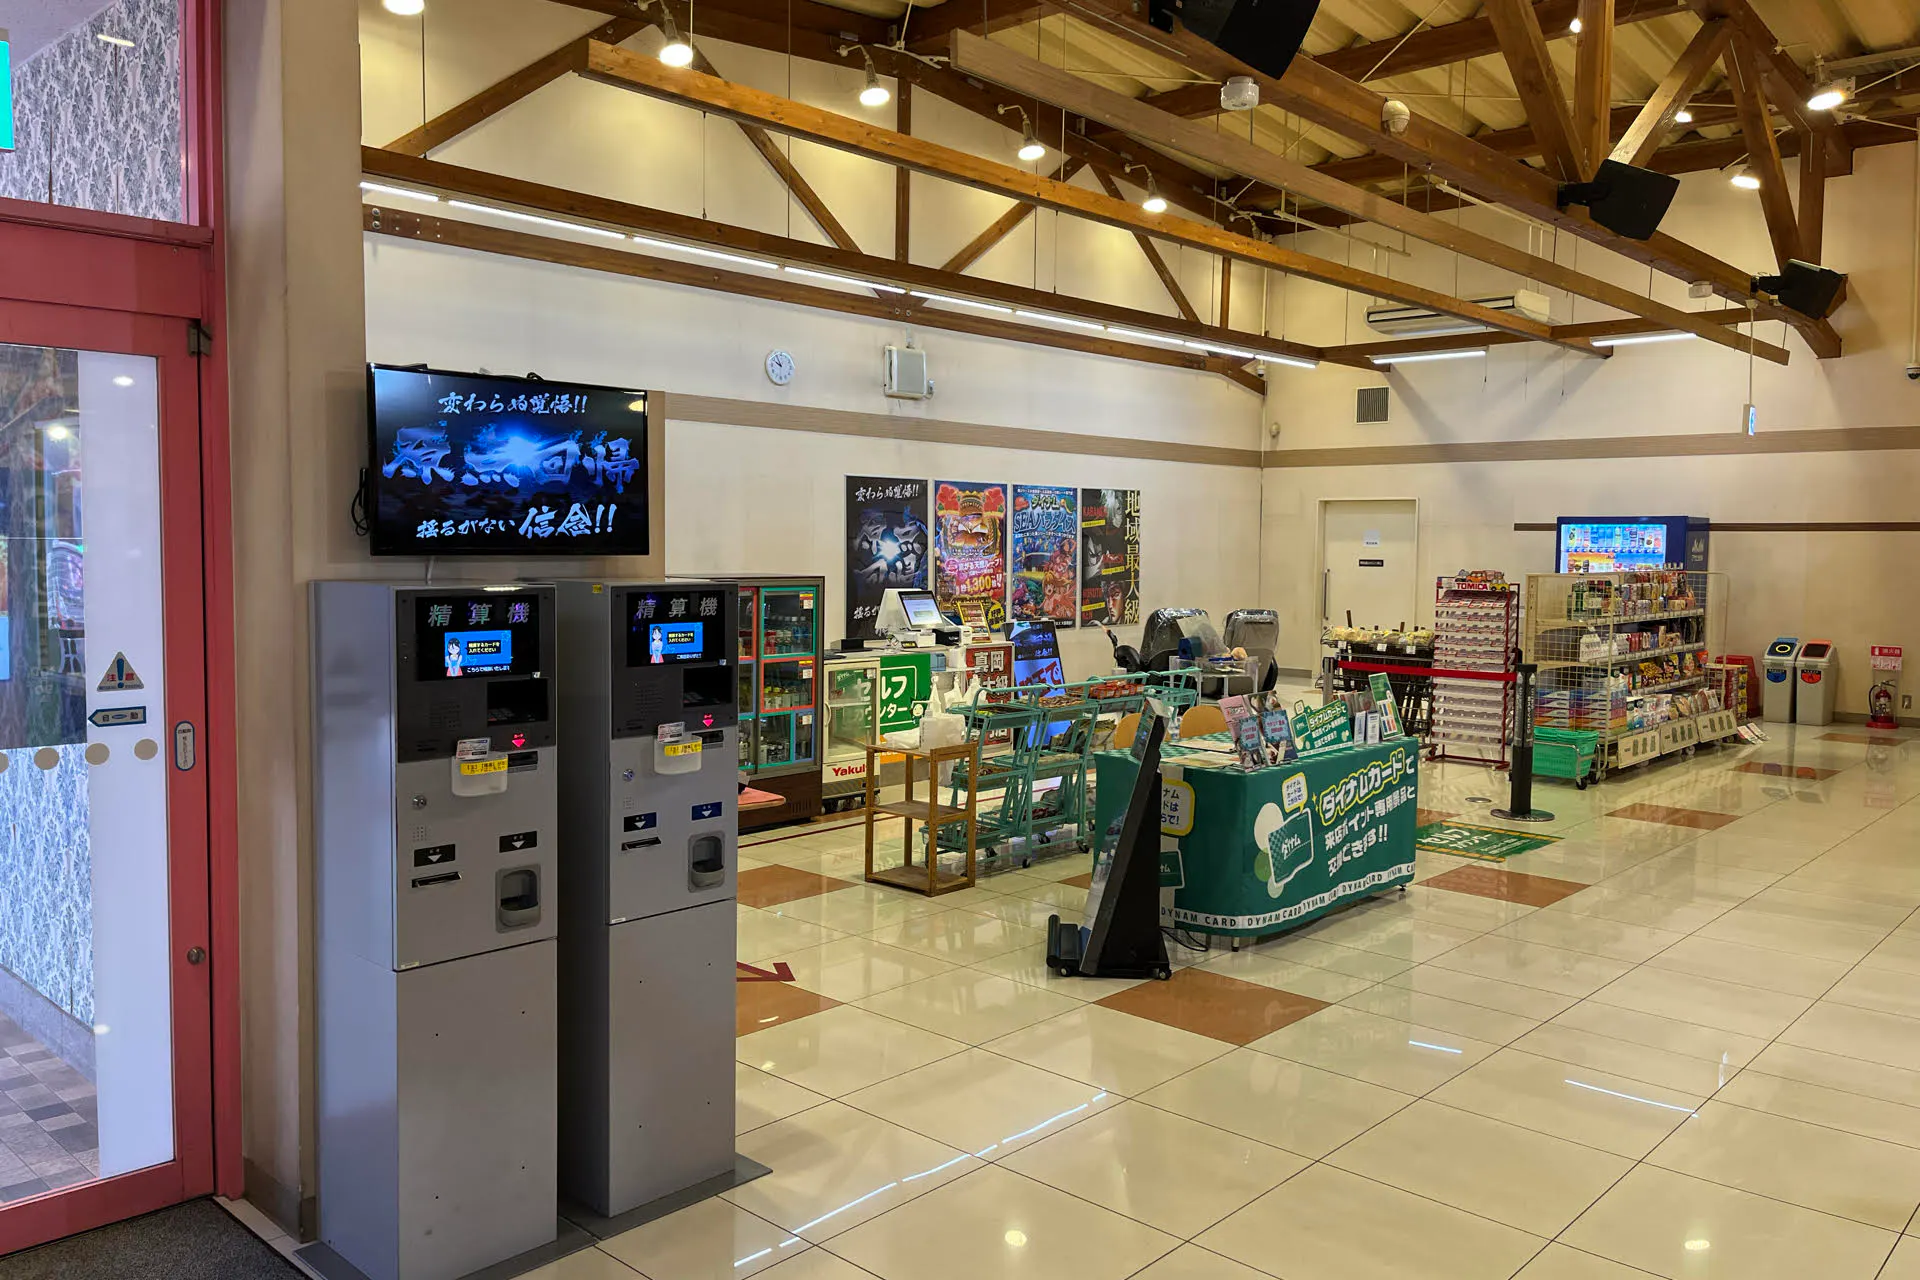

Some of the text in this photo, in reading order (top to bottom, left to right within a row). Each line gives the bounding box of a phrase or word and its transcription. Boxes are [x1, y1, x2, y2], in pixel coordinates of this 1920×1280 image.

[438, 391, 588, 415] 変わらぬ覚悟!!
[1124, 489, 1140, 624] 地域最大級
[1456, 582, 1488, 590] TOMICA
[428, 602, 530, 627] 精算機
[636, 597, 718, 620] 精算機
[832, 764, 866, 777] Yakul
[1204, 916, 1237, 928] CARD
[1247, 913, 1281, 927] DYNAM
